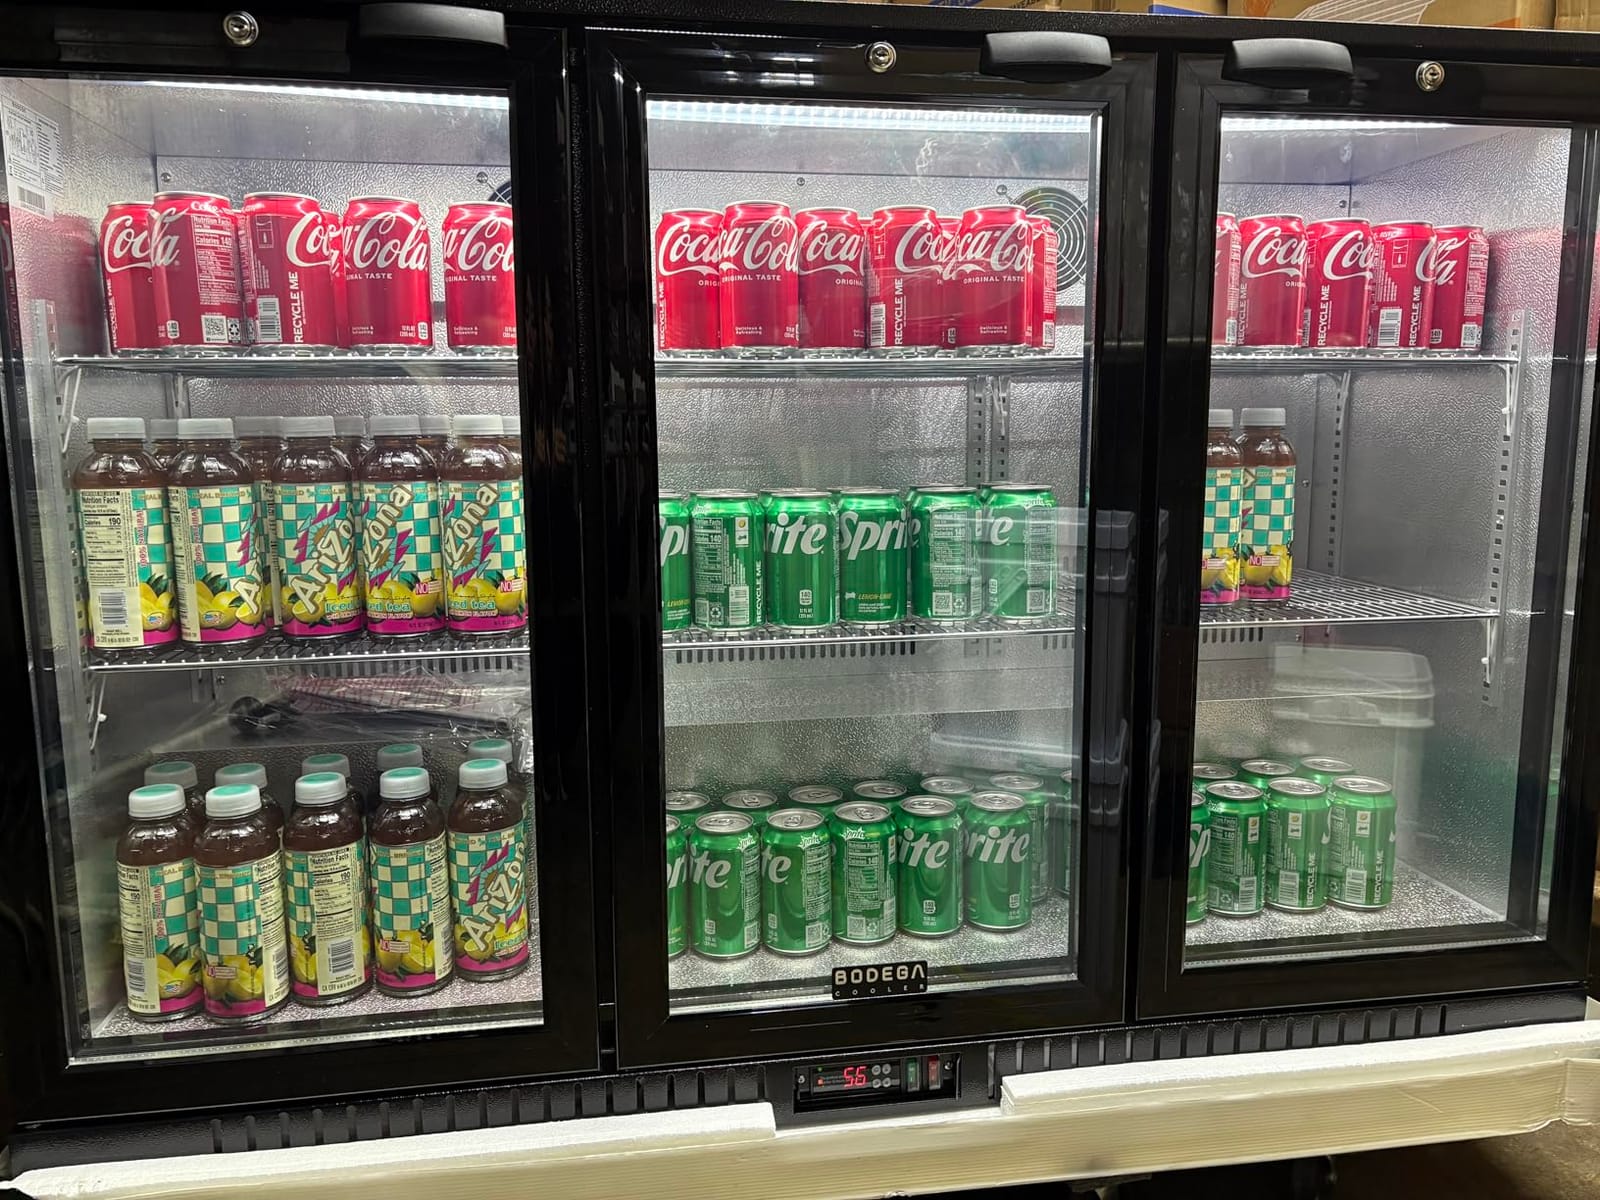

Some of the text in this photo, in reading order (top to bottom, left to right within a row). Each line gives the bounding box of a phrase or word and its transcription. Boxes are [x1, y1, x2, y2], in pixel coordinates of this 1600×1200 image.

[104, 214, 152, 273] Coc
[286, 211, 331, 267] Coc
[963, 276, 999, 284] ORIGINAL
[288, 271, 303, 344] RECYCLE ME
[894, 278, 903, 345] RECYCLE ME
[1318, 284, 1330, 346] RECYCLE ME
[1409, 286, 1421, 346] RECYCLE ME
[108, 517, 122, 525] 190
[415, 582, 429, 595] NO
[500, 581, 513, 593] NO
[386, 602, 411, 612] tea
[471, 599, 495, 609] tea
[340, 871, 350, 881] 190
[1307, 865, 1316, 906] RECYCLE
[834, 963, 925, 986] BODEGA
[835, 984, 924, 997] COOLER
